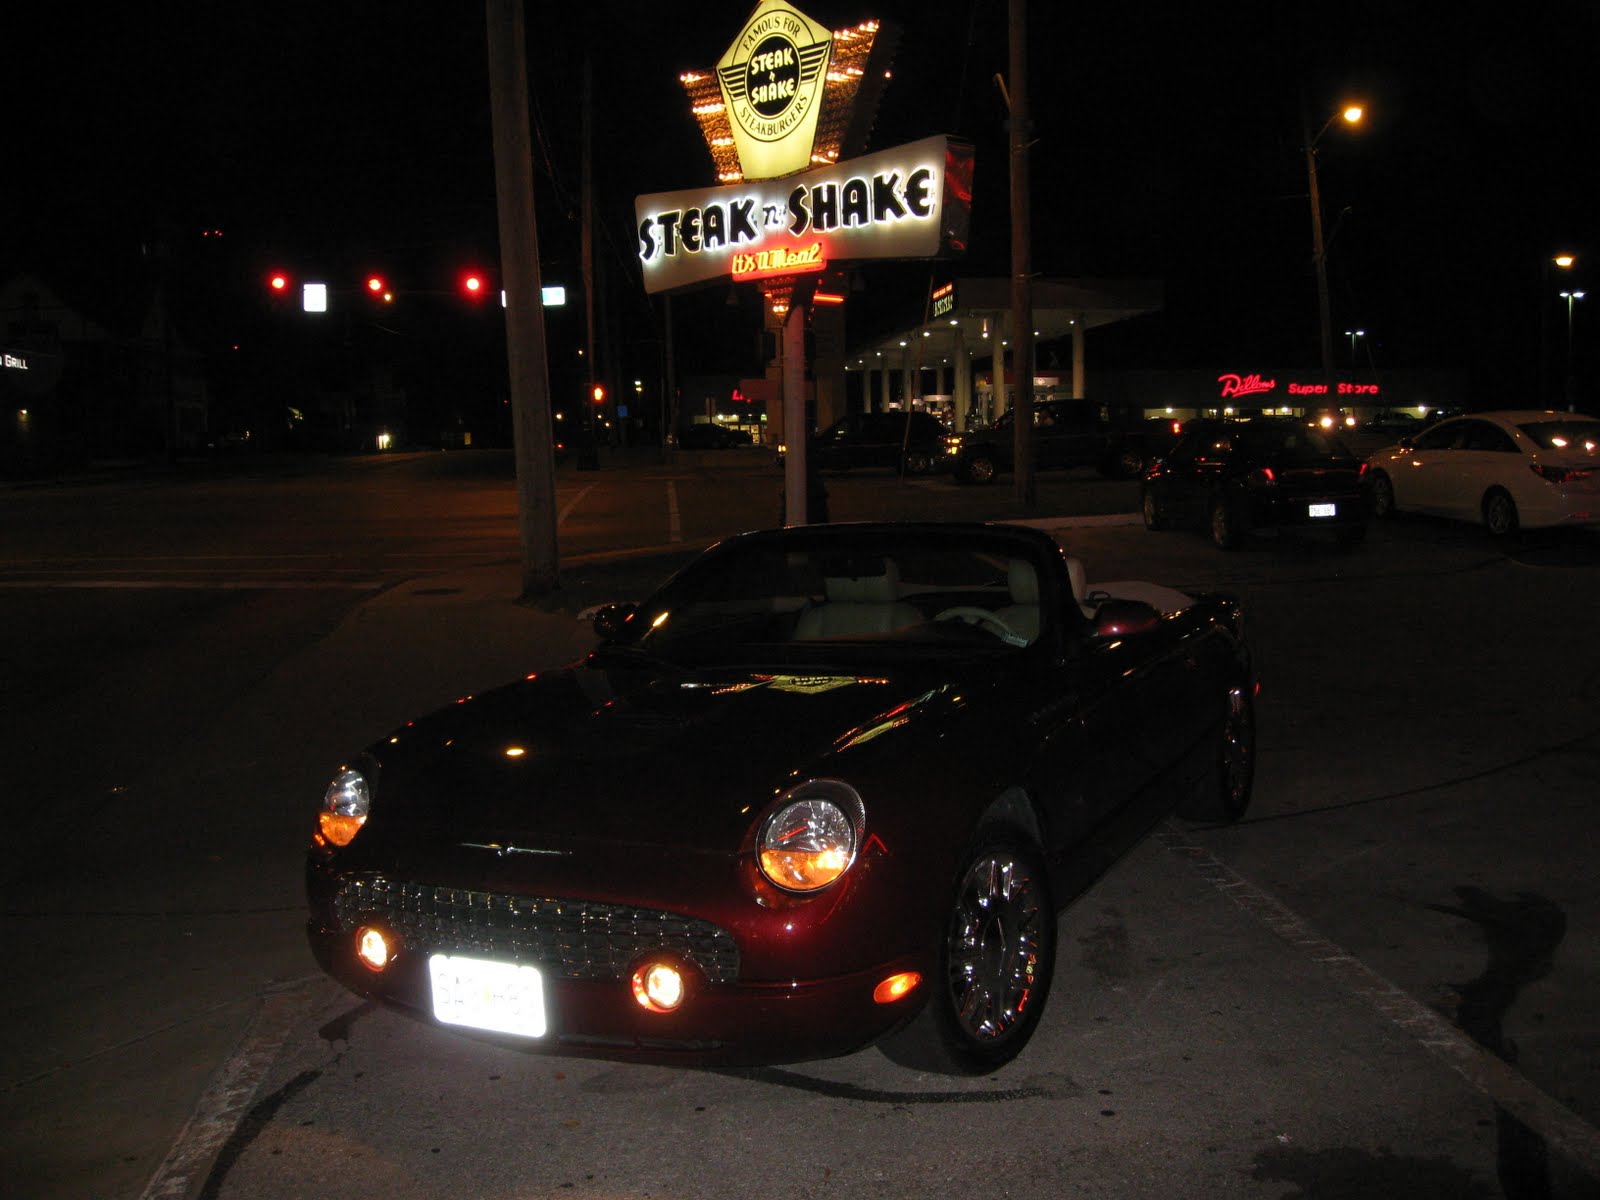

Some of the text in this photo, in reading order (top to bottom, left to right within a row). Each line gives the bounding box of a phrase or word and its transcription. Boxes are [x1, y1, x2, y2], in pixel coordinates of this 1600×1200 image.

[742, 16, 801, 51] FAMOUS FOR
[750, 47, 794, 76] STEAK
[751, 78, 795, 105] SHAKE
[740, 94, 808, 136] STEAKBURGERS
[639, 197, 759, 264] STEAK
[788, 166, 936, 237] SHAKE
[1217, 373, 1276, 398] Dillons
[1337, 383, 1379, 395] Store
